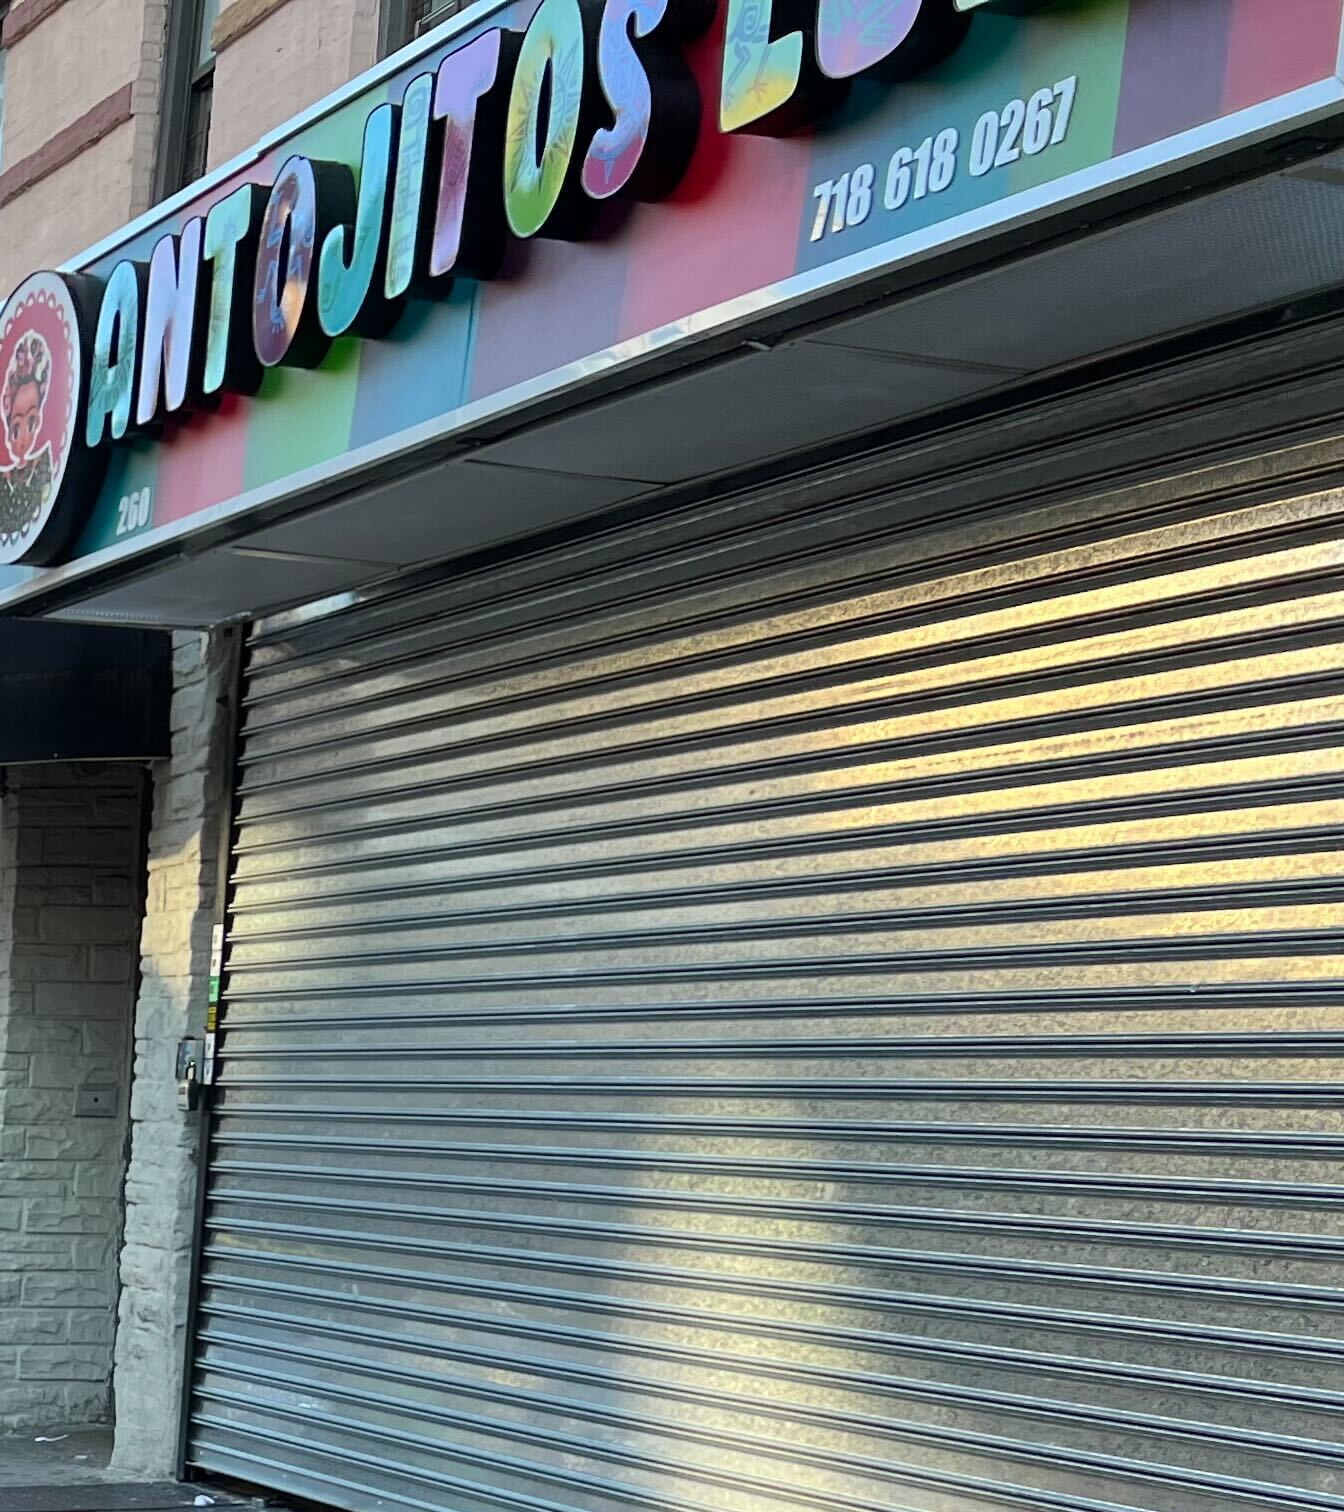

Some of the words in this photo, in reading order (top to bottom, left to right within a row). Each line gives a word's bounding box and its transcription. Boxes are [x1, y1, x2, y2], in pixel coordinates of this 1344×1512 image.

[85, 0, 670, 448] ANTOJITOS
[810, 164, 876, 243] 718
[884, 127, 959, 210] 618
[969, 76, 1078, 178] 0267
[116, 487, 152, 536] 260
